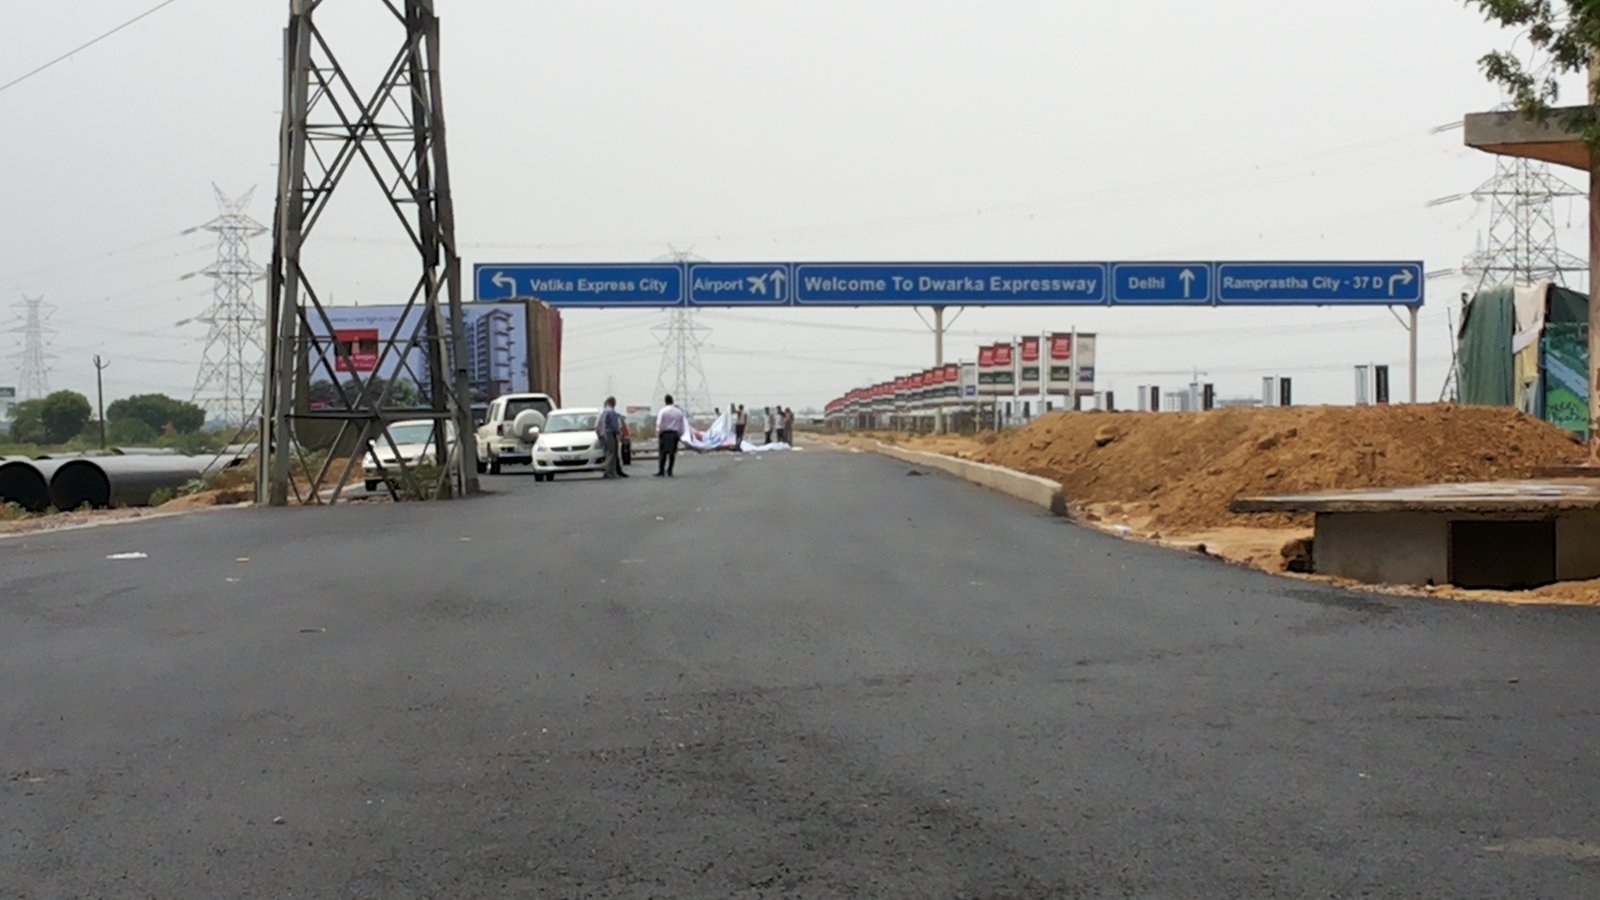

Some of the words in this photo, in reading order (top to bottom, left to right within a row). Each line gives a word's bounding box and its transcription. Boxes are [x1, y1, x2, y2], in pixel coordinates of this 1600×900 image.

[530, 279, 573, 291] Vatika
[577, 279, 635, 293] Express
[639, 279, 668, 293] City
[693, 278, 743, 291] Airport
[804, 277, 886, 292] Welcome
[892, 277, 913, 291] To
[919, 277, 985, 291] Dwarka
[990, 277, 1097, 293] Expressway
[1128, 276, 1165, 290] Delhi
[1223, 276, 1308, 291] Ramprastha
[1312, 276, 1340, 291] City
[1352, 276, 1370, 289] 37
[1372, 276, 1383, 289] D
